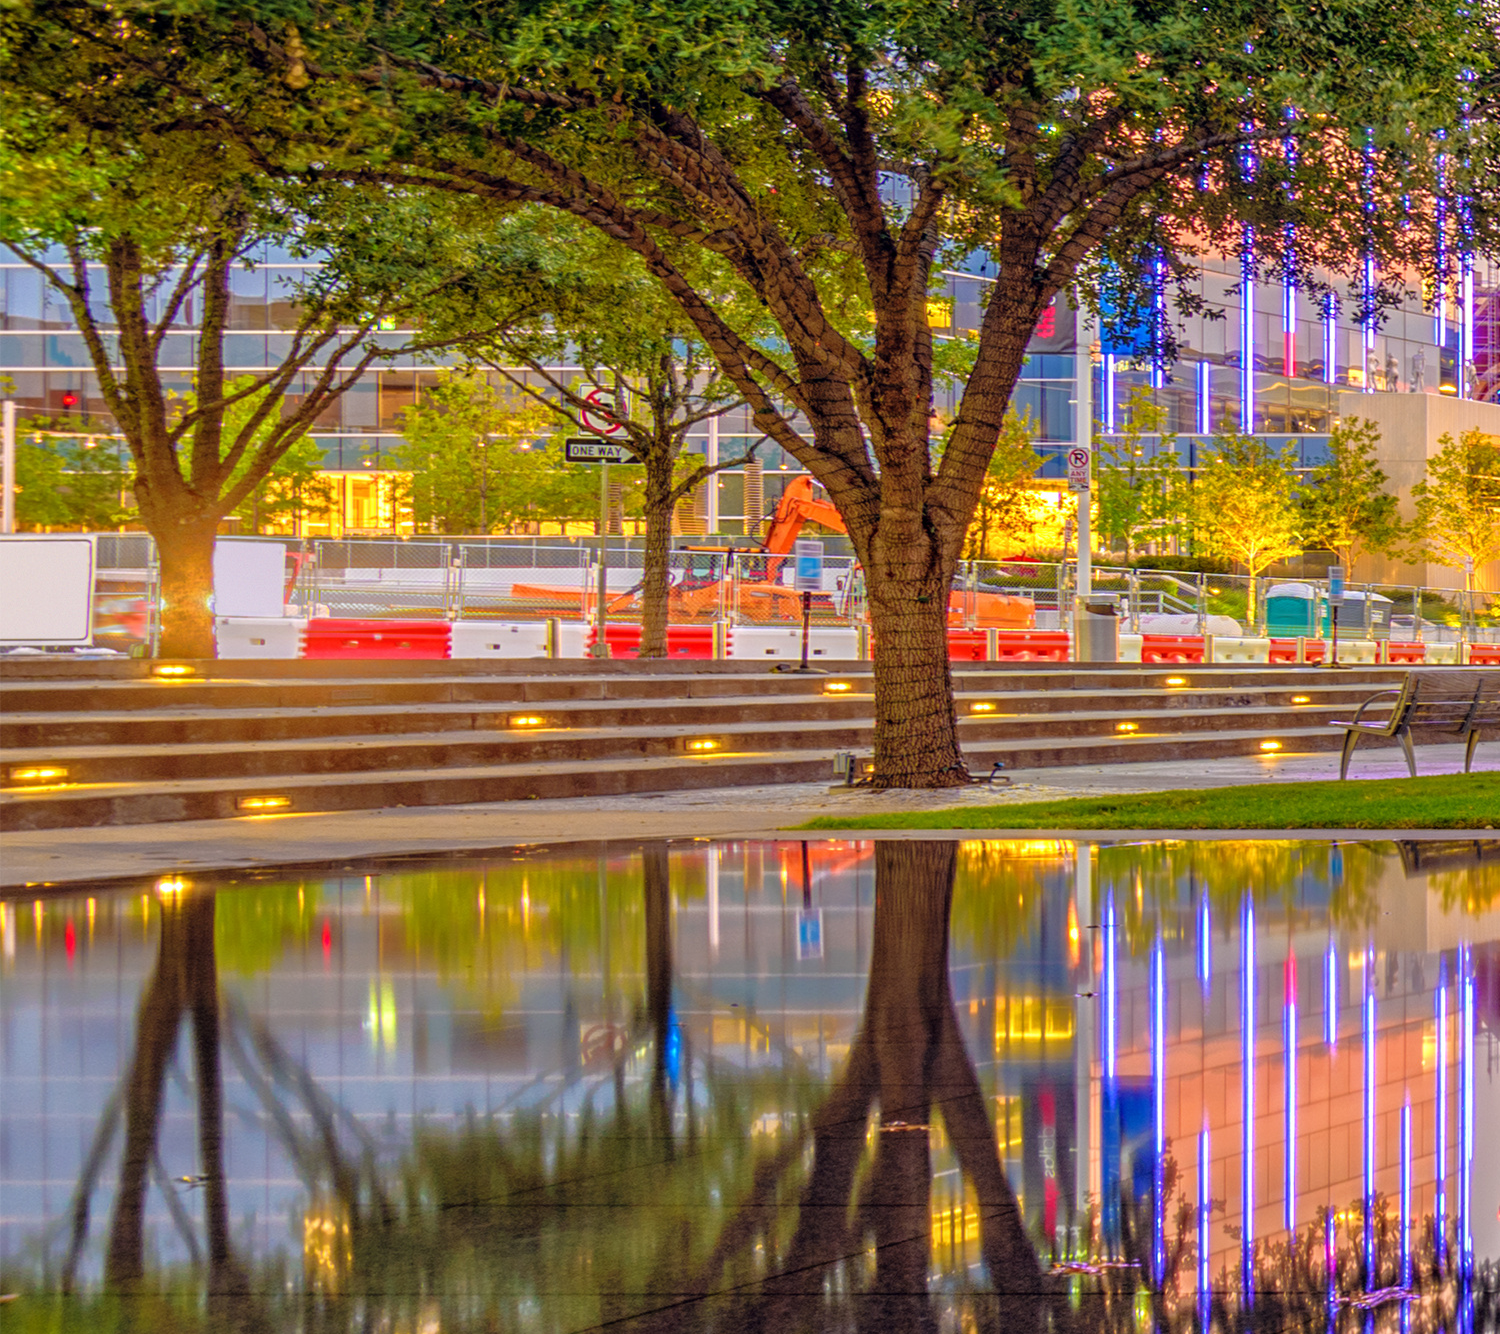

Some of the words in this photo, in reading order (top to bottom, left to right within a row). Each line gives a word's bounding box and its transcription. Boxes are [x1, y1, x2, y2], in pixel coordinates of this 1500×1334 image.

[1036, 306, 1056, 339] the
[572, 446, 595, 456] ONE
[598, 446, 622, 456] WAY
